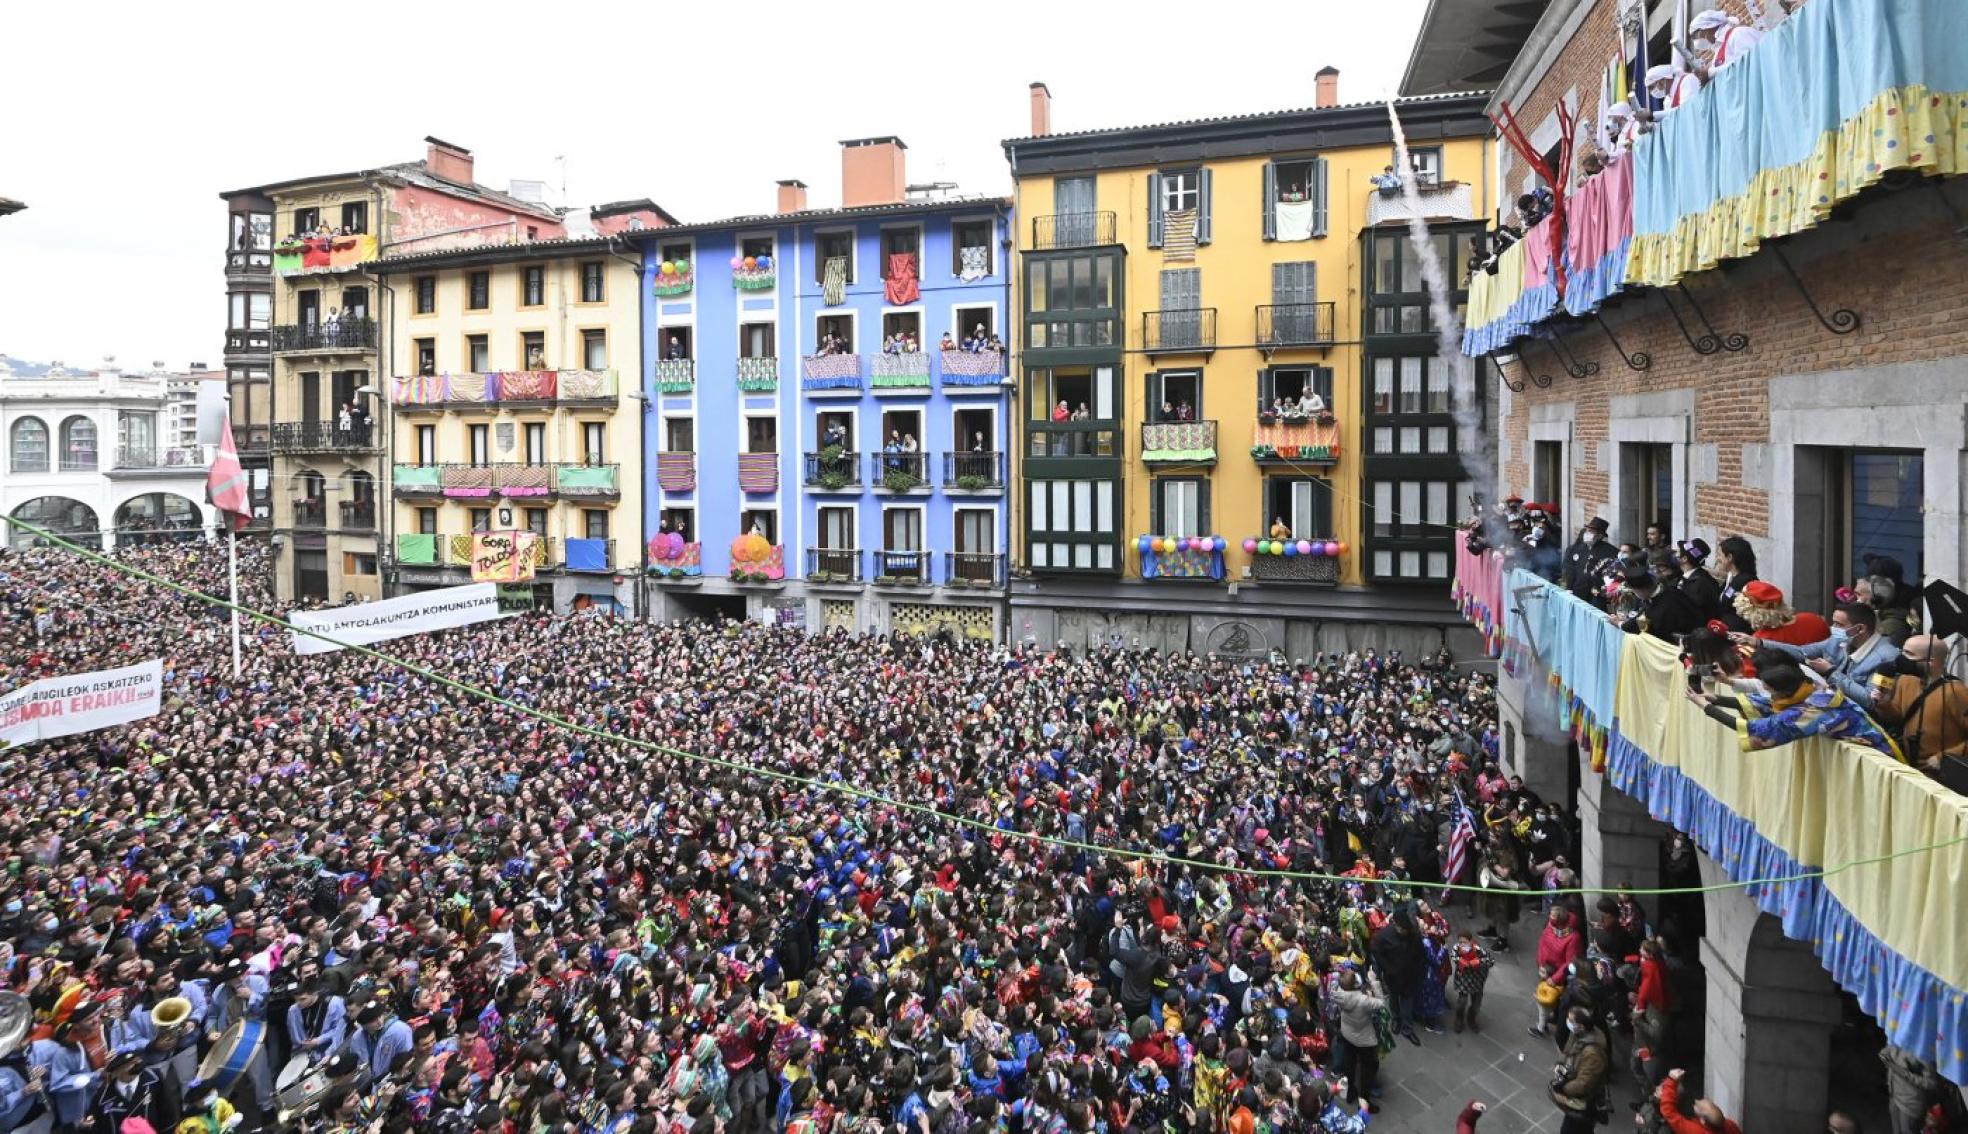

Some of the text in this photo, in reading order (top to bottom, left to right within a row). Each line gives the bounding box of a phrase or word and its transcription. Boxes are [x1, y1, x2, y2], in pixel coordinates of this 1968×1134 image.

[334, 609, 420, 630] ANTOLAKUNTZA
[0, 673, 152, 711] UME LANGILEOK ASKATZEKO
[0, 700, 63, 728] ISMOA
